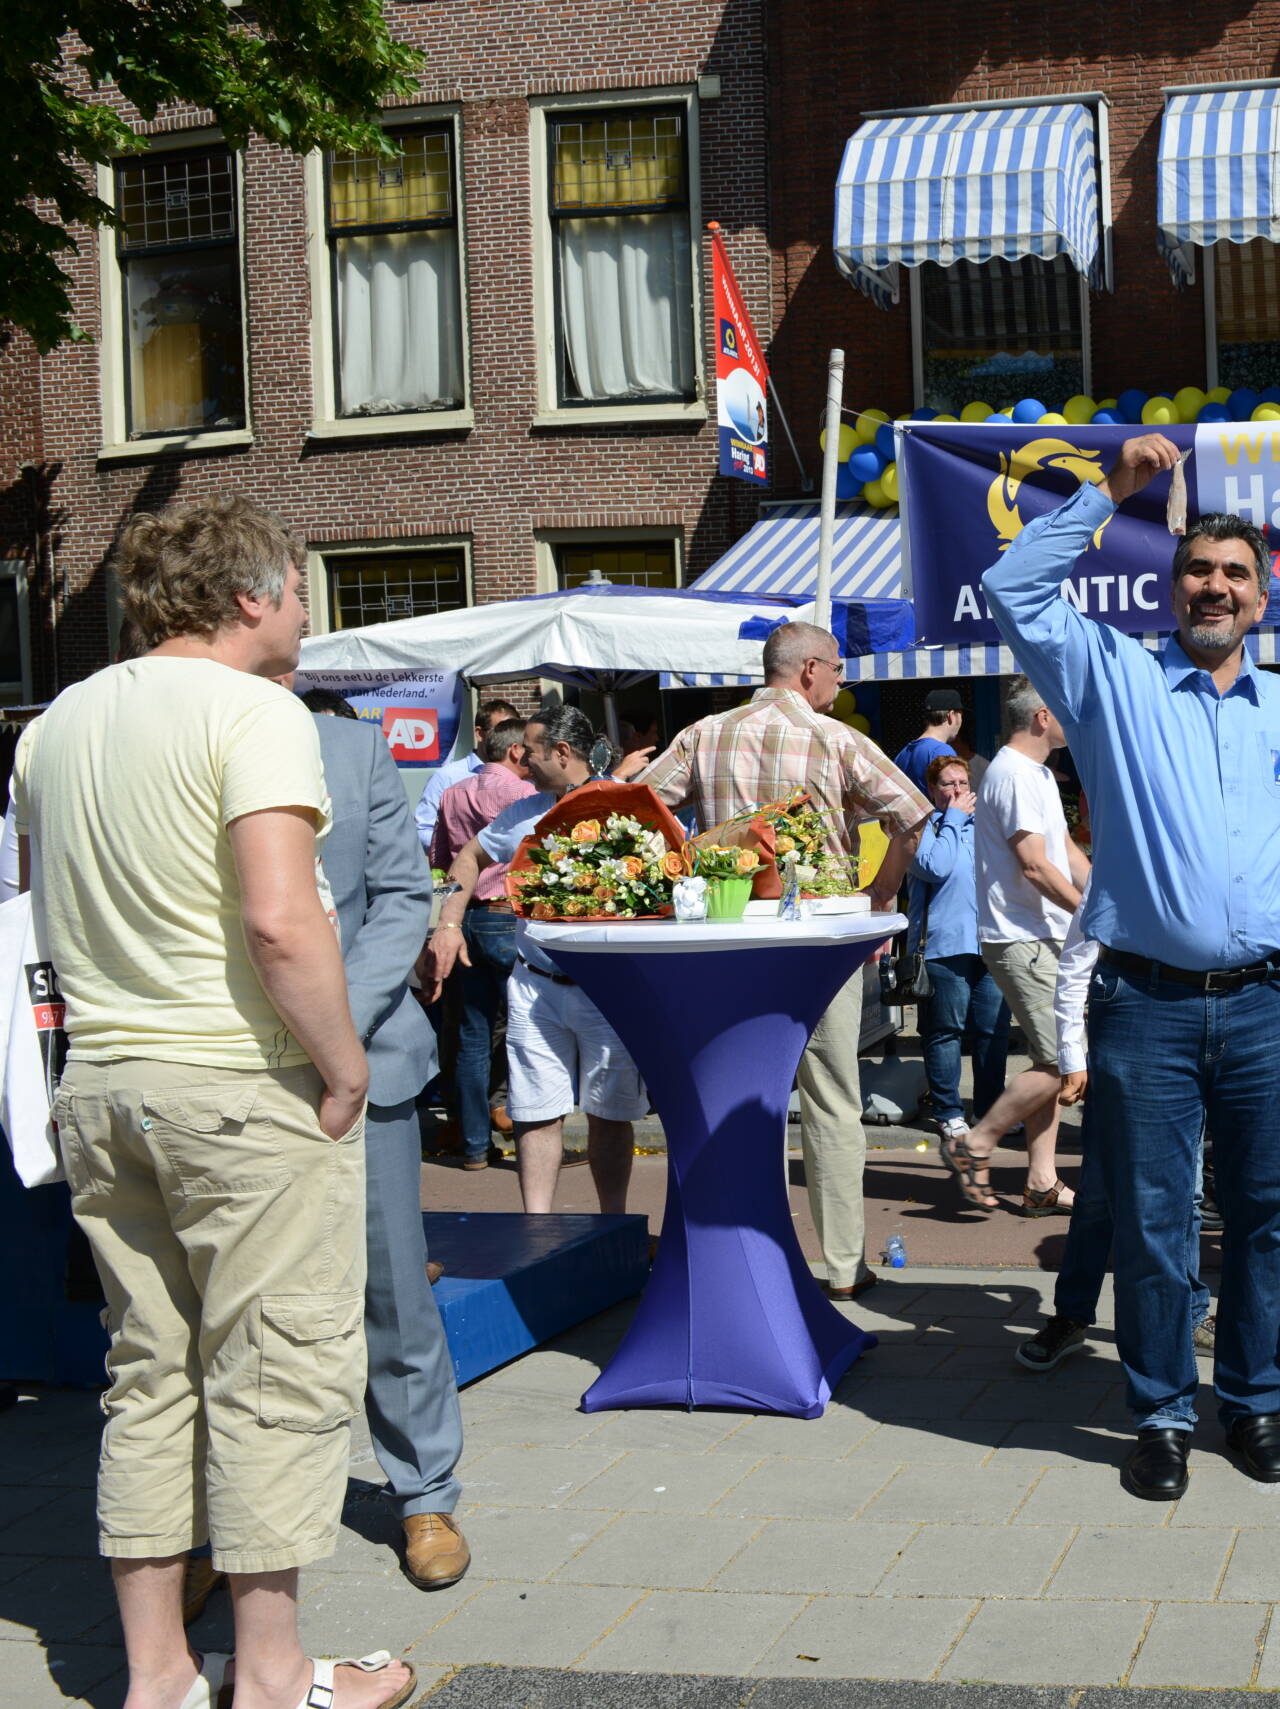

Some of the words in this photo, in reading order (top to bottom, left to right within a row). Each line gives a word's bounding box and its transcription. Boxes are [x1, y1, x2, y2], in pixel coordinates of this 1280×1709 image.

[754, 453, 766, 472] AD
[953, 573, 1159, 622] ANTIC
[321, 674, 342, 682] ons
[343, 673, 362, 682] eet
[363, 672, 373, 682] U
[375, 672, 390, 682] de
[392, 672, 444, 683] Lekkerste
[350, 688, 370, 697] van
[387, 718, 435, 749] AD
